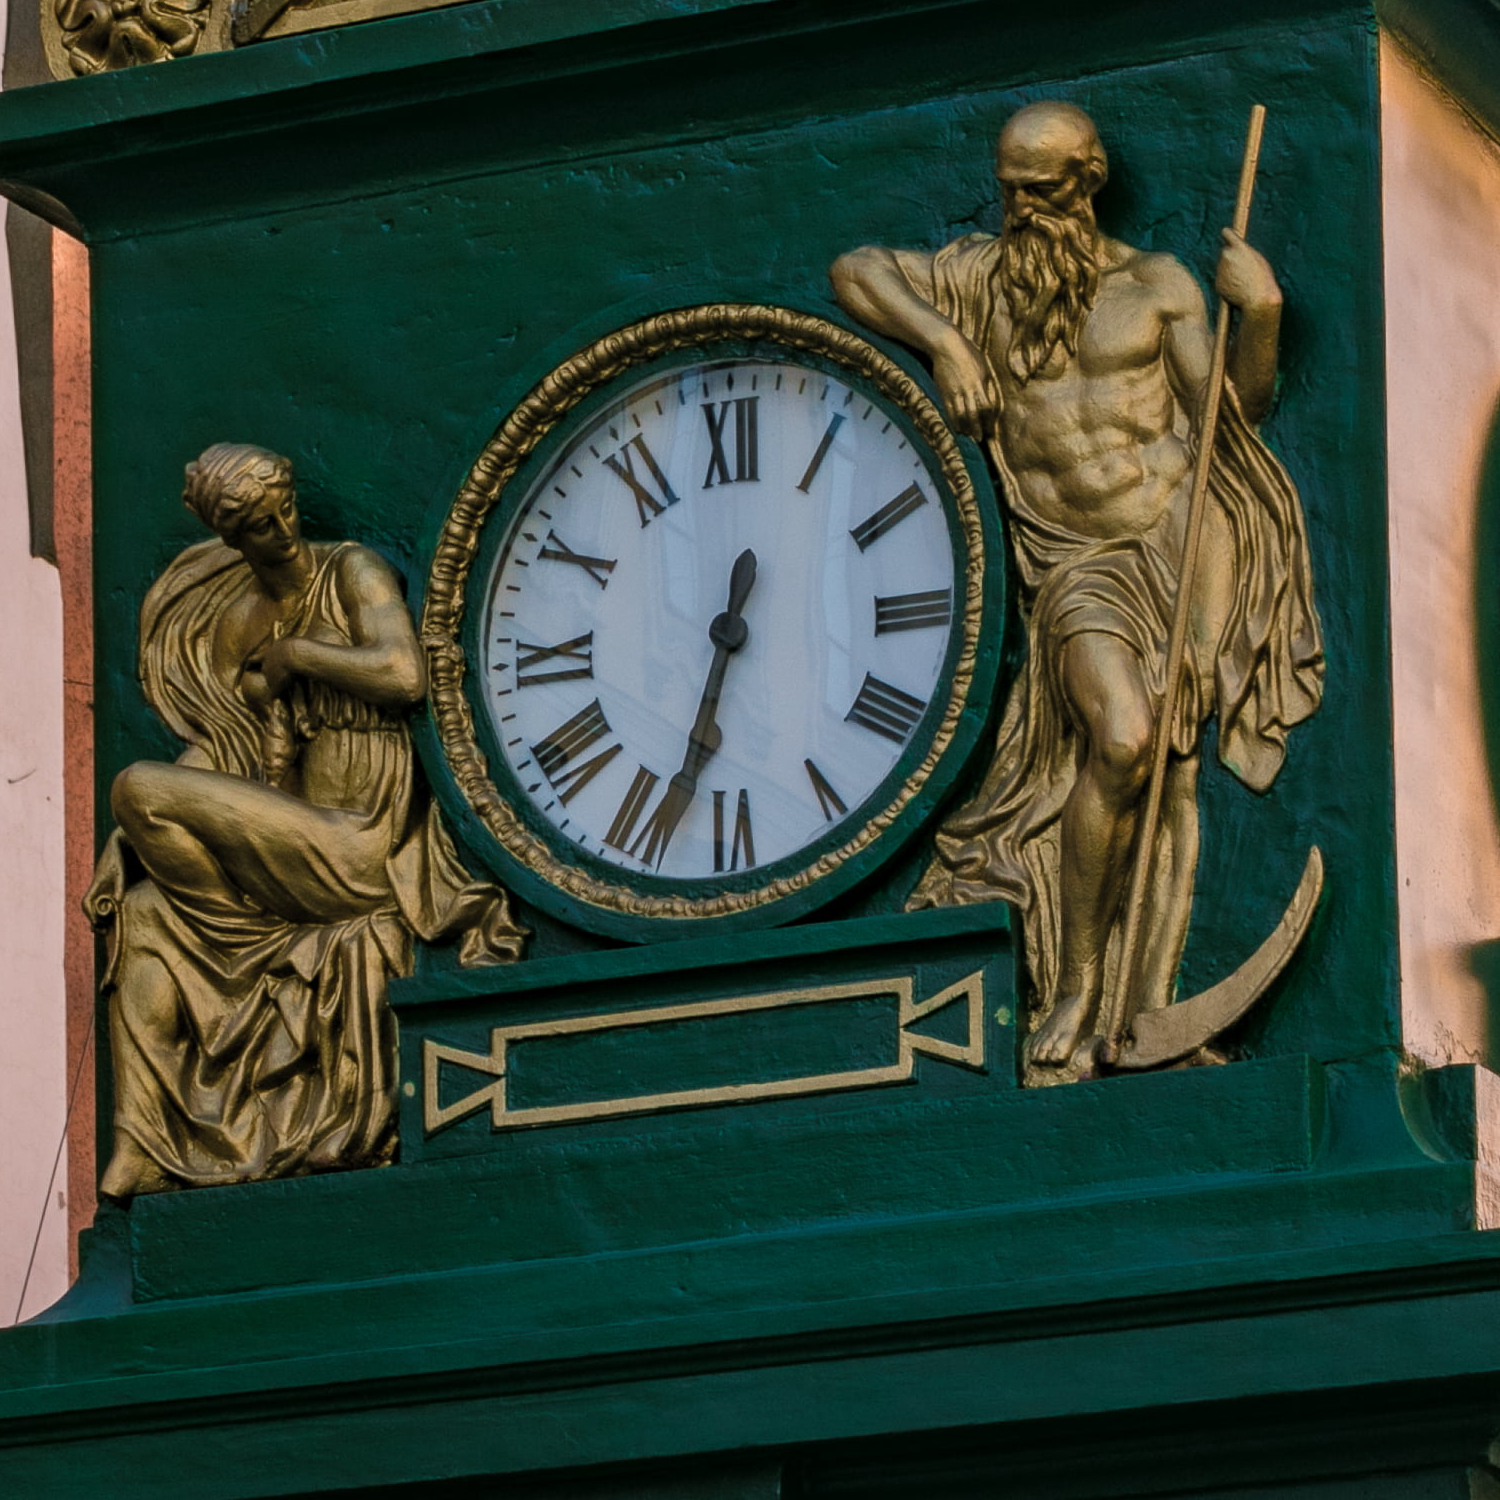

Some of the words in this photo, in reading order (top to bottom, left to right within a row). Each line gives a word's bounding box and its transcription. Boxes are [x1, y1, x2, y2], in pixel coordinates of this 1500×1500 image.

[702, 395, 761, 489] XII
[796, 412, 847, 494] I
[603, 434, 681, 528] XI
[848, 481, 929, 554] II
[537, 530, 618, 590] X
[873, 587, 952, 638] III
[515, 631, 594, 691] IX
[844, 671, 928, 745] IIII
[529, 698, 624, 808] VIII
[803, 758, 848, 821] V
[711, 787, 756, 873] VI
